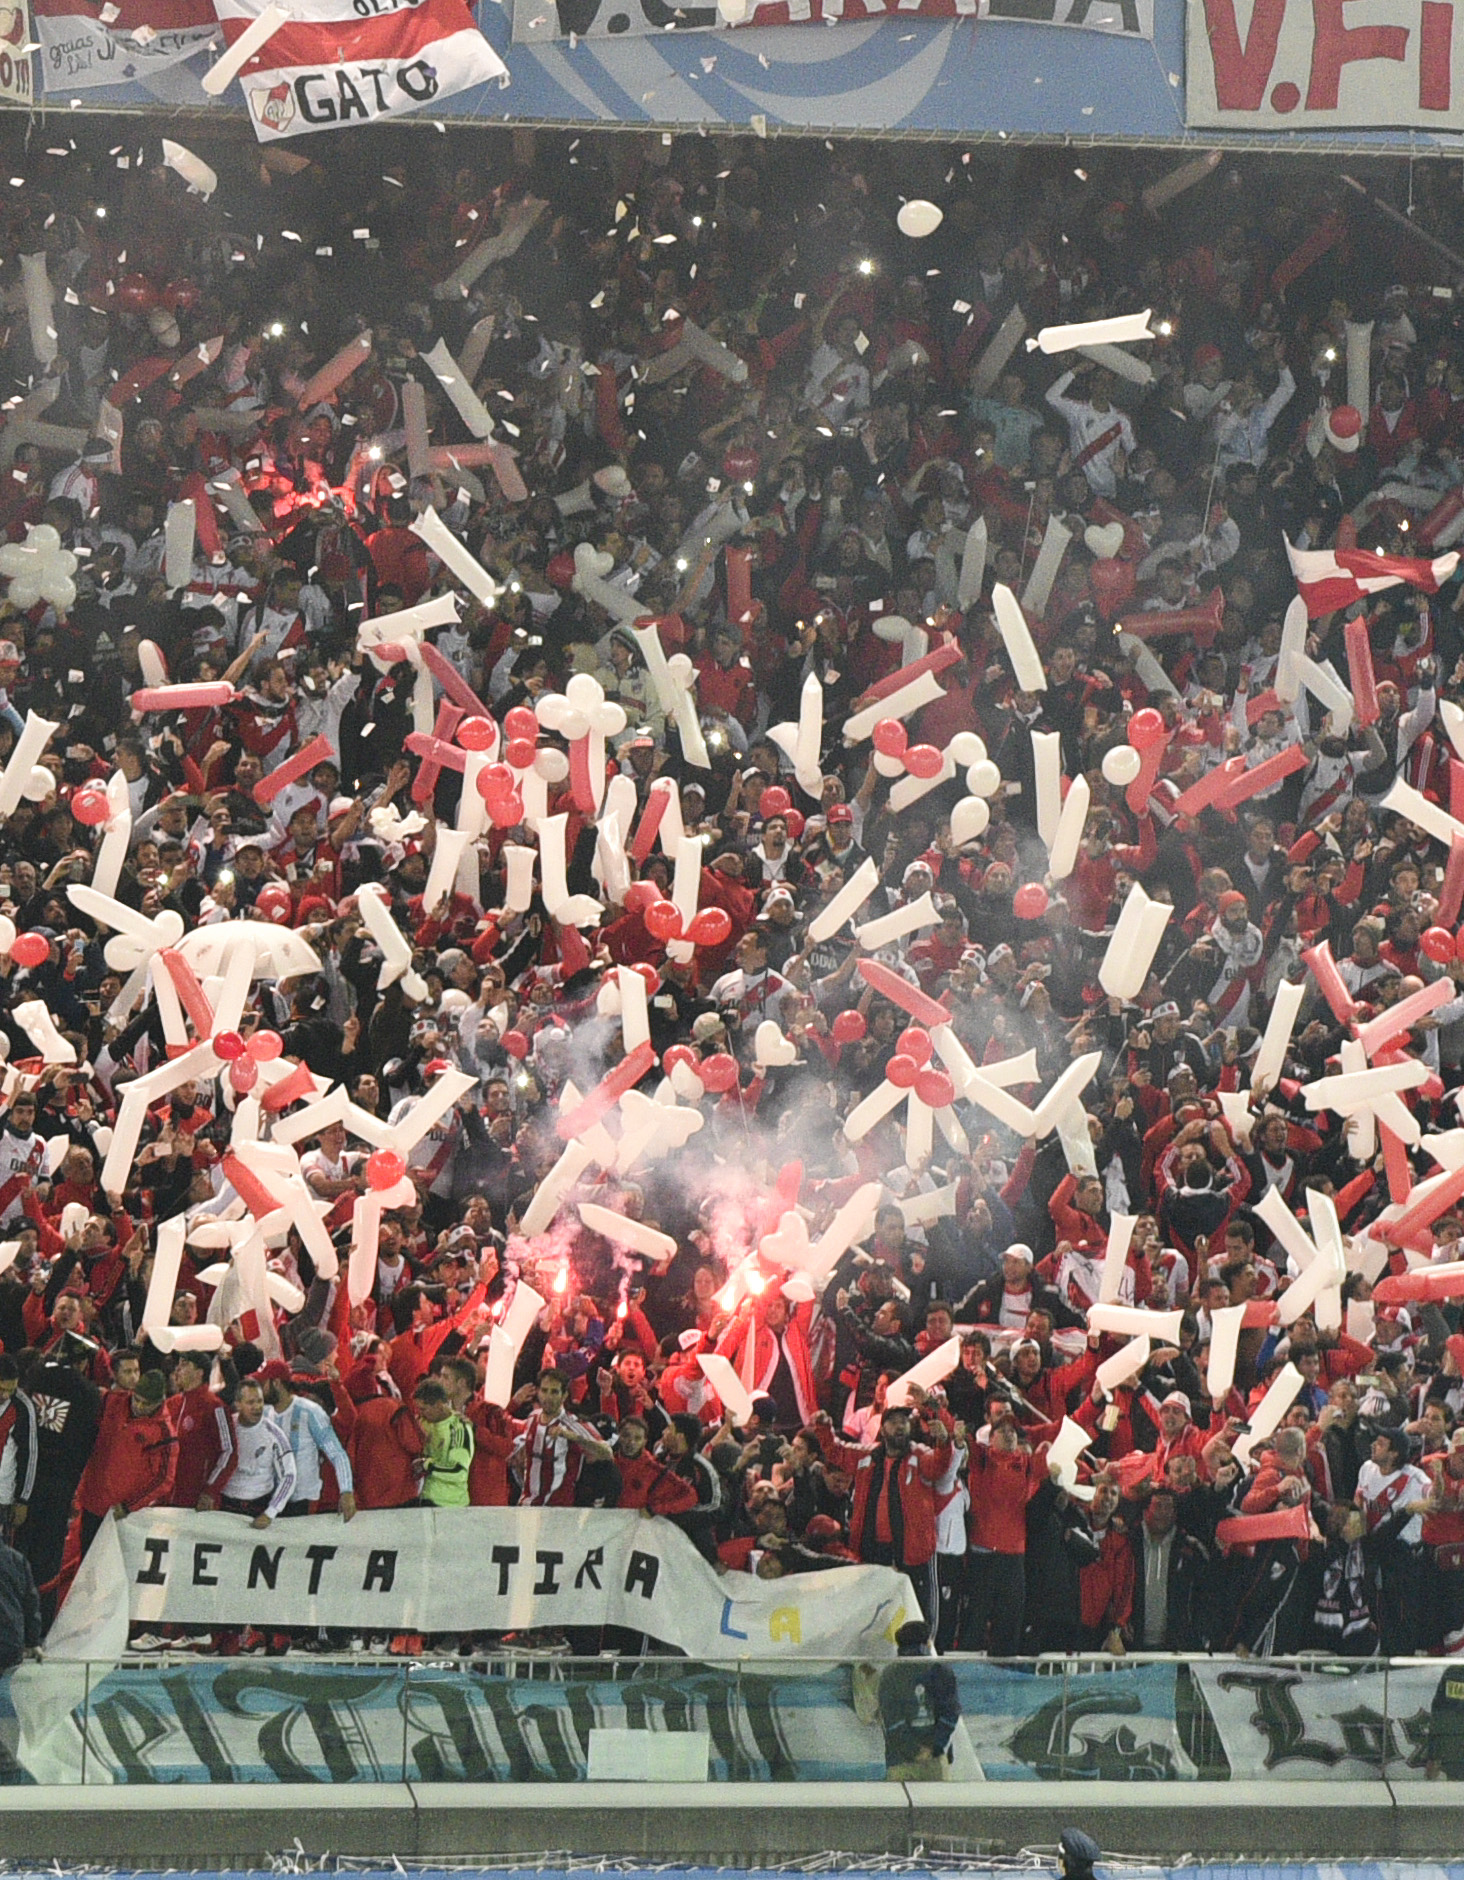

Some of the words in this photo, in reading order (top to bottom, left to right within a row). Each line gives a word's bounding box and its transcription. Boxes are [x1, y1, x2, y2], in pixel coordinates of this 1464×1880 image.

[292, 60, 439, 124] GATO
[135, 1536, 399, 1594] IENTA
[490, 1543, 661, 1599] TIRA
